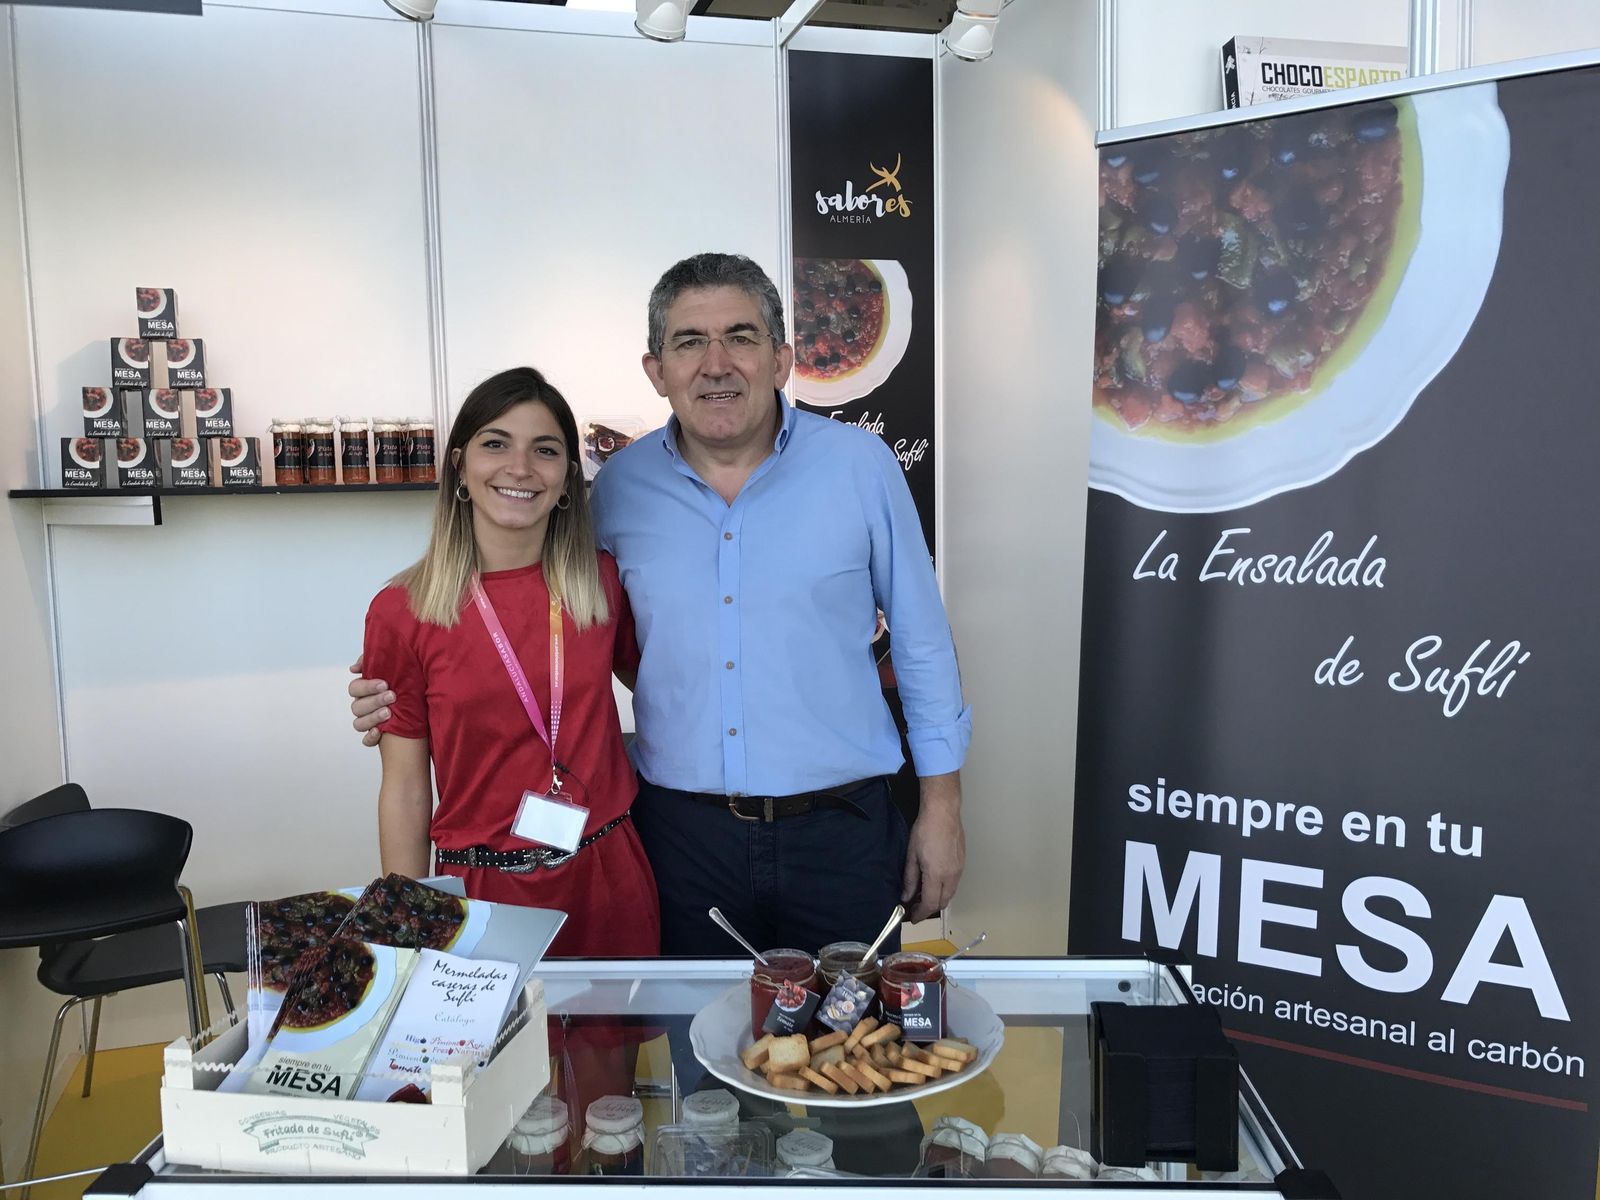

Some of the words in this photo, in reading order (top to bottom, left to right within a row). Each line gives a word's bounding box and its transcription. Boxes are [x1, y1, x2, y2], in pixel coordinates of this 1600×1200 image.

[1262, 85, 1300, 94] CHOCOLATES
[815, 180, 913, 218] sabores
[829, 214, 872, 224] ALMERÍA
[147, 321, 174, 329] MESA
[114, 370, 141, 378] MESA
[177, 371, 203, 379] MESA
[93, 420, 120, 428] MESA
[145, 421, 172, 429] MESA
[64, 470, 92, 478] MESA
[127, 470, 154, 478] MESA
[180, 470, 207, 478] MESA
[229, 469, 255, 477] MESA
[1132, 529, 1178, 581] La
[1198, 527, 1388, 589] Ensalada
[1313, 635, 1365, 686] de
[1388, 635, 1531, 718] Suflí
[1127, 777, 1325, 837] siempre
[1341, 811, 1407, 848] en
[1426, 812, 1483, 858] tu
[1121, 840, 1571, 1022] MESA
[432, 959, 508, 981] Mermeladas
[431, 980, 477, 992] caseras
[480, 980, 496, 991] de
[904, 1017, 932, 1027] MESA
[1274, 997, 1415, 1047] artesanal
[1427, 1029, 1455, 1054] al
[1467, 1038, 1585, 1078] carbón
[279, 1056, 311, 1068] siempre
[323, 1064, 332, 1072] tu
[265, 1064, 342, 1097] MESA
[263, 1123, 304, 1139] Fritada
[306, 1123, 320, 1135] de
